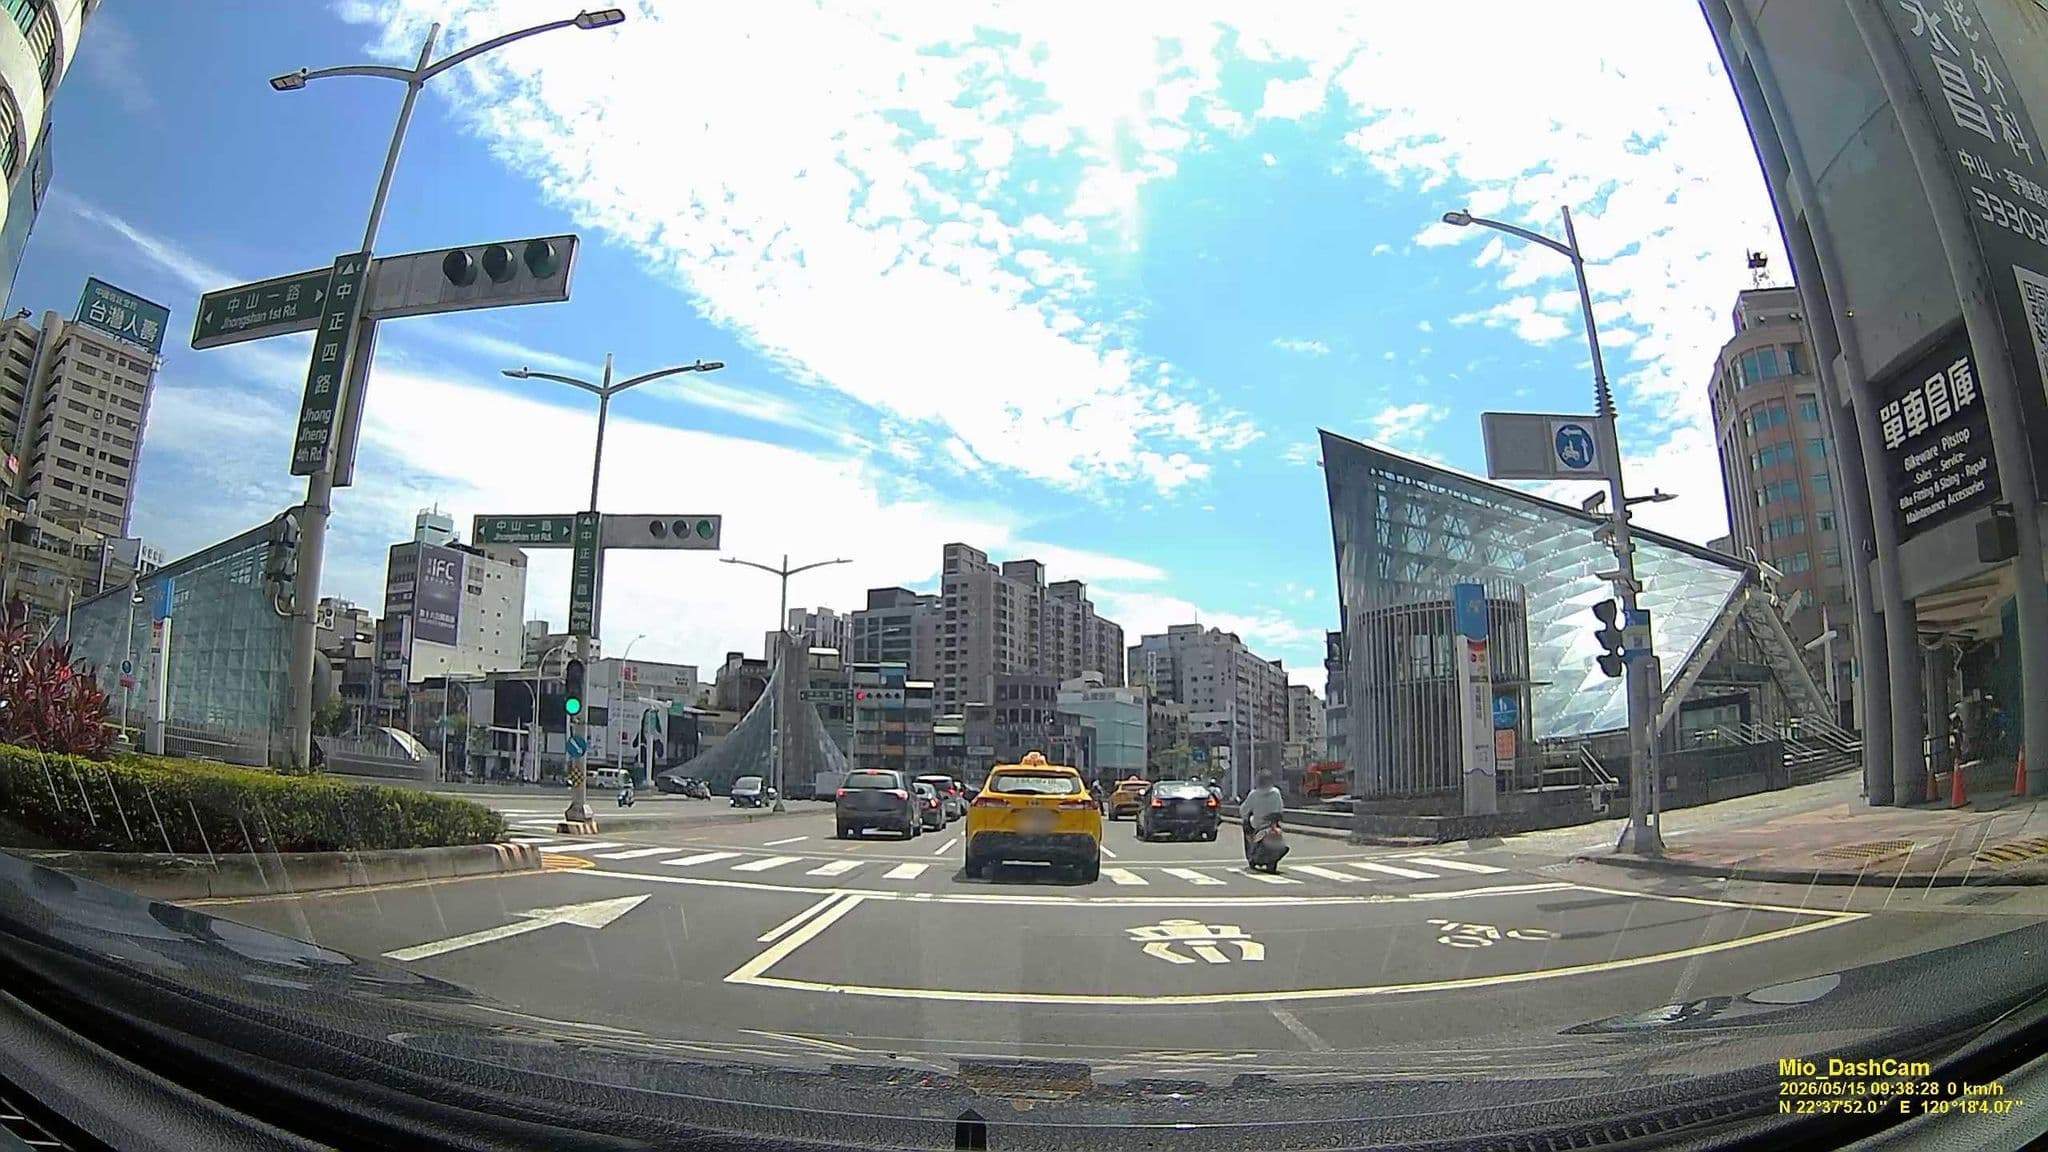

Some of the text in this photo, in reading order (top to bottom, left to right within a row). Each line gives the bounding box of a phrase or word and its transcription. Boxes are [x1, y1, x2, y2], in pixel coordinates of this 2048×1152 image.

[1971, 186, 2048, 247] 33303
[227, 284, 300, 313] 中山一路
[89, 300, 159, 342] 台灣人壽
[221, 309, 267, 330] Jhongshan
[268, 307, 281, 321] 1st
[314, 283, 353, 395] 中正四路
[303, 408, 331, 424] Jhong
[299, 427, 328, 444] Jheng
[1941, 428, 1970, 451] Pitstop
[1965, 456, 1987, 477] Repair
[1947, 480, 1985, 506] Accessories
[496, 520, 553, 532] 中山一路
